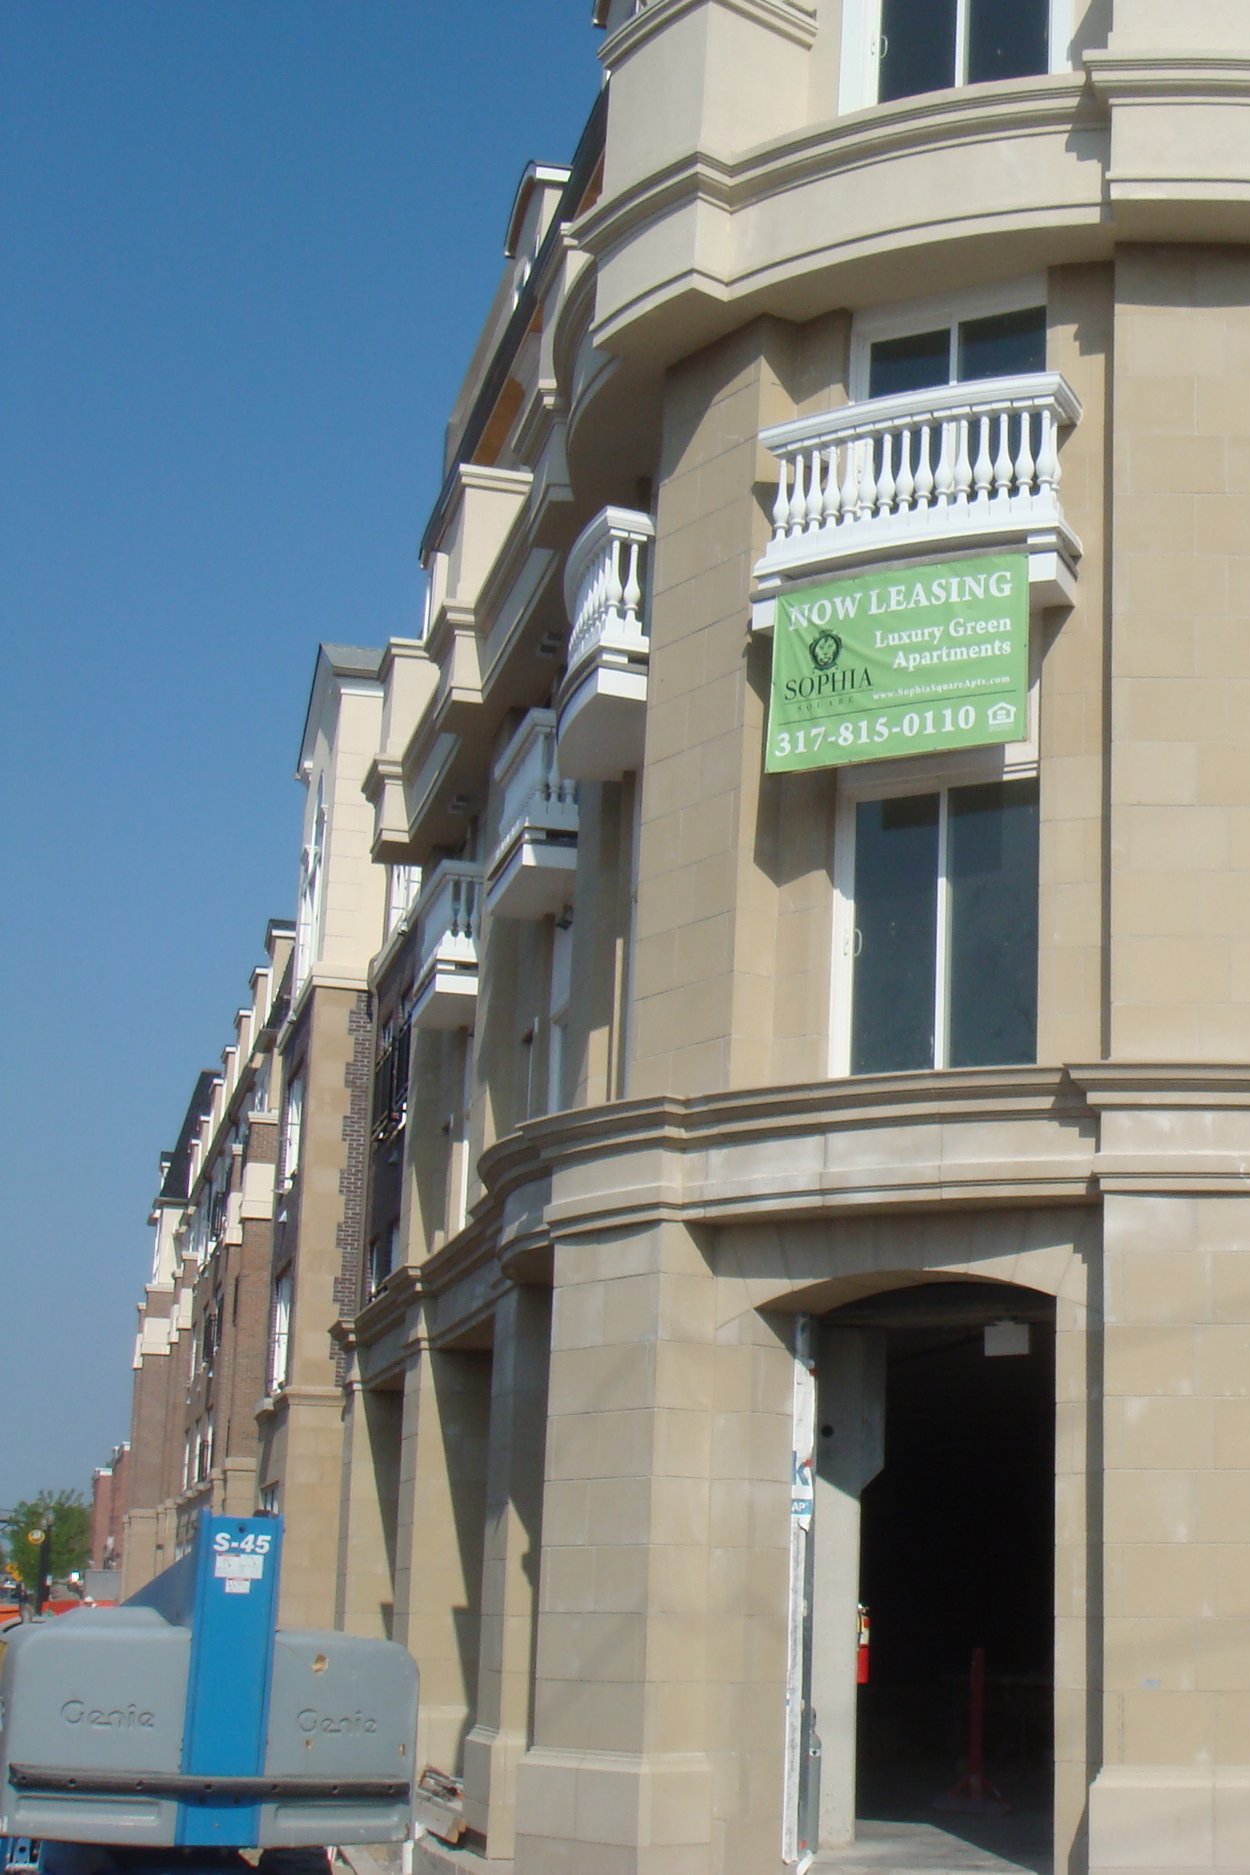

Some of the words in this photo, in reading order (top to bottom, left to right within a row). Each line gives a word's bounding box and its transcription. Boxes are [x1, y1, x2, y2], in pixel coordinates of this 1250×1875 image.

[788, 592, 862, 631] NOW
[868, 571, 1013, 616] LEASING
[874, 626, 944, 649] Luxury
[949, 617, 1012, 637] Green
[892, 640, 1012, 672] Apartments
[784, 667, 873, 701] SOPHIA
[775, 705, 976, 757] 317-815-0110
[212, 1532, 272, 1554] S-45
[60, 1699, 156, 1731] Genie
[296, 1707, 379, 1735] Genie
